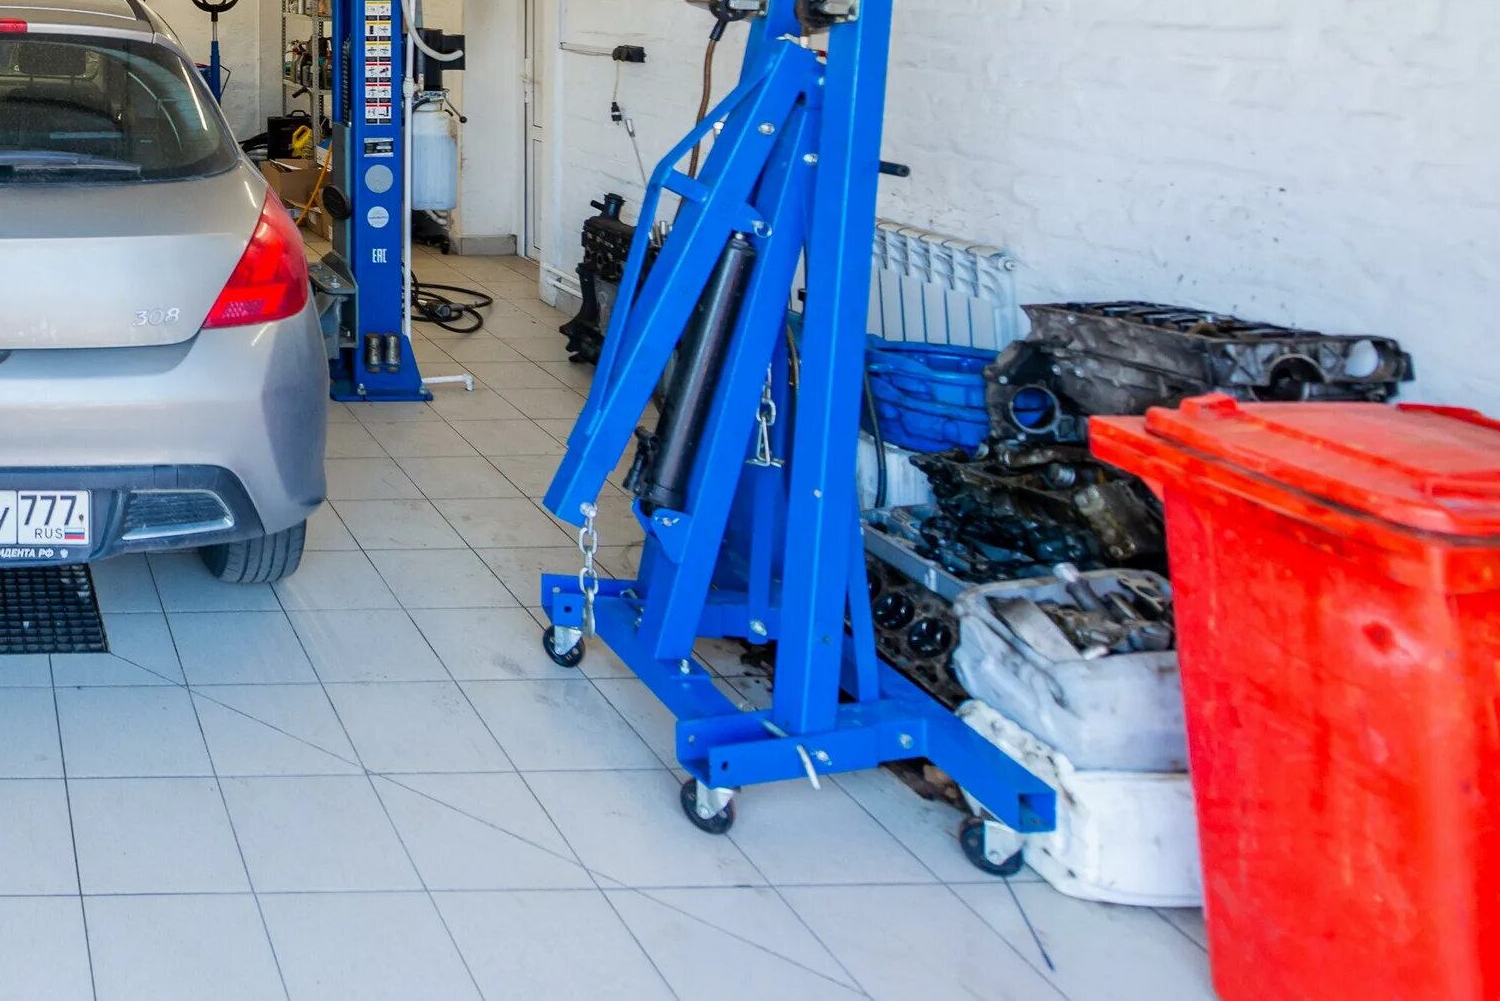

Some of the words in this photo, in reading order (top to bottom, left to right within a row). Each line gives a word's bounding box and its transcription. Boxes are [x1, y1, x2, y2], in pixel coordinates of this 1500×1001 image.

[372, 248, 388, 264] EAC
[132, 307, 180, 327] 308
[20, 495, 78, 526] 777
[34, 528, 63, 540] RUS
[38, 549, 54, 559] РФ
